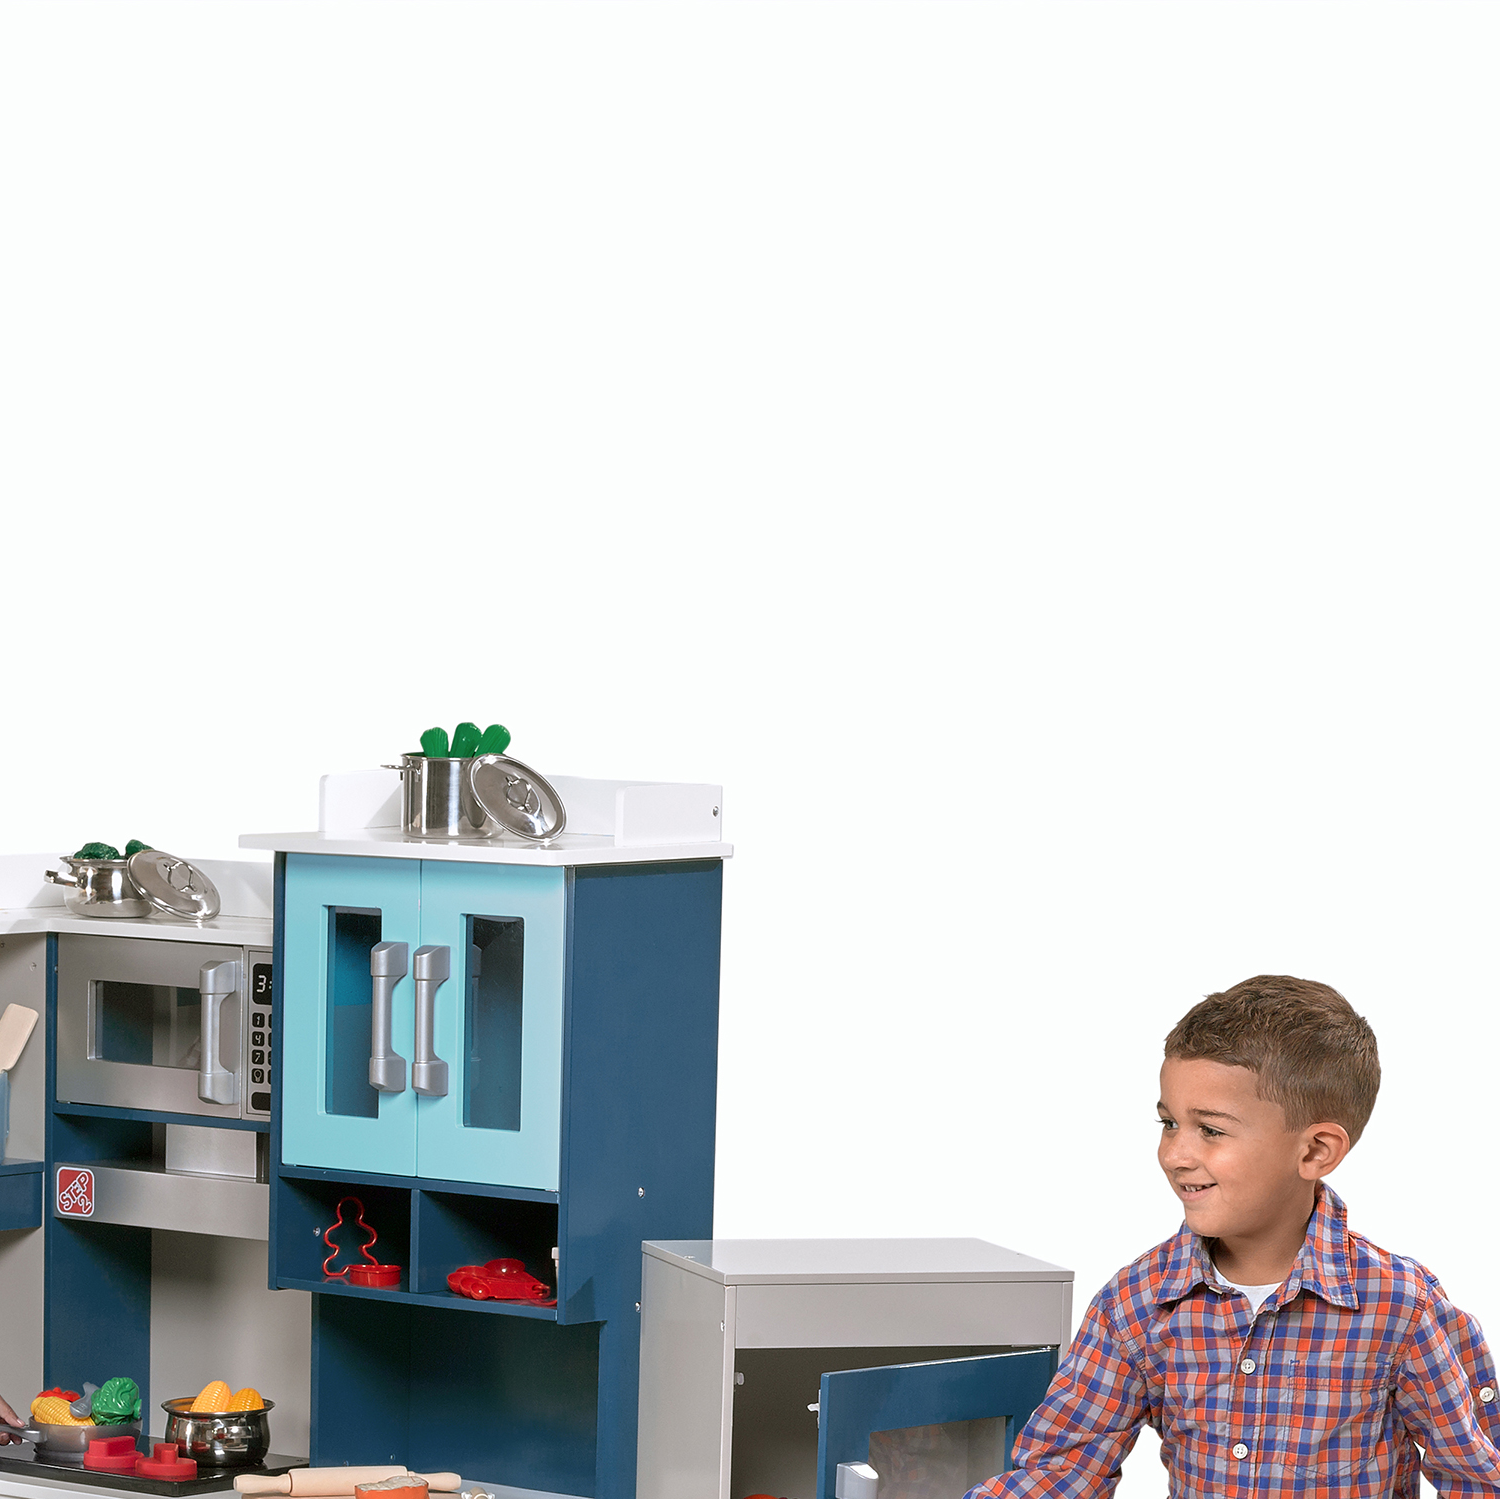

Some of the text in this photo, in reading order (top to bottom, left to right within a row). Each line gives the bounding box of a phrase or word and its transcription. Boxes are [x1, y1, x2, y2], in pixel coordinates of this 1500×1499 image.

[255, 1034, 261, 1044] 4
[255, 1052, 260, 1063] 7
[60, 1172, 88, 1210] STEP
[78, 1194, 92, 1213] 2
